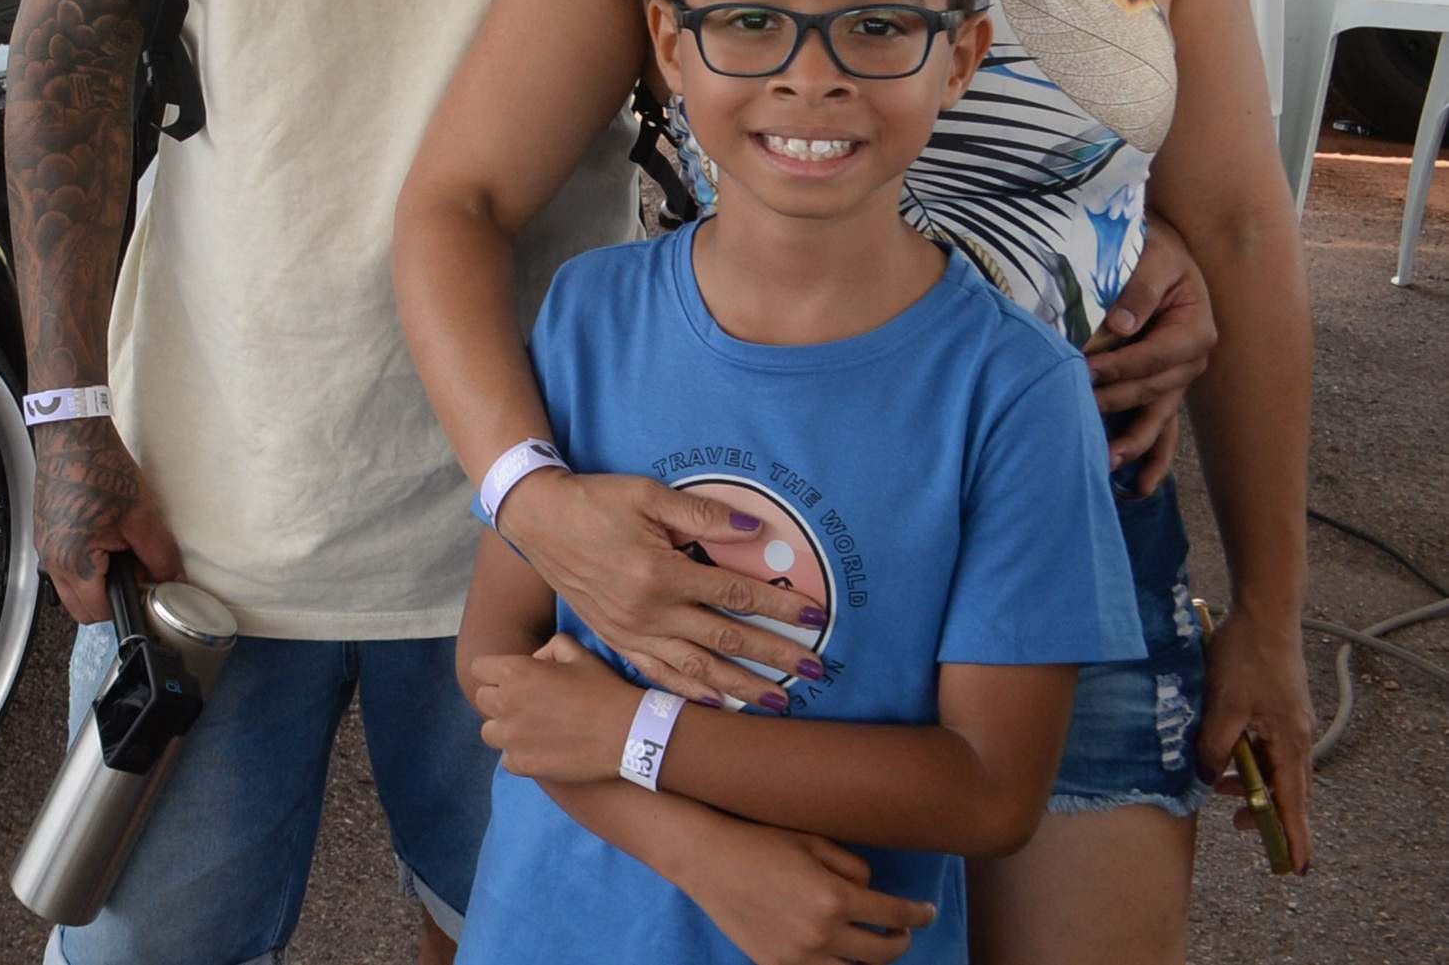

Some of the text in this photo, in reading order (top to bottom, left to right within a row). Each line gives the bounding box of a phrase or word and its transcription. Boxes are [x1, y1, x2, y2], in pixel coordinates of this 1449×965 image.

[652, 446, 868, 609] TRAVEL THE WORLD
